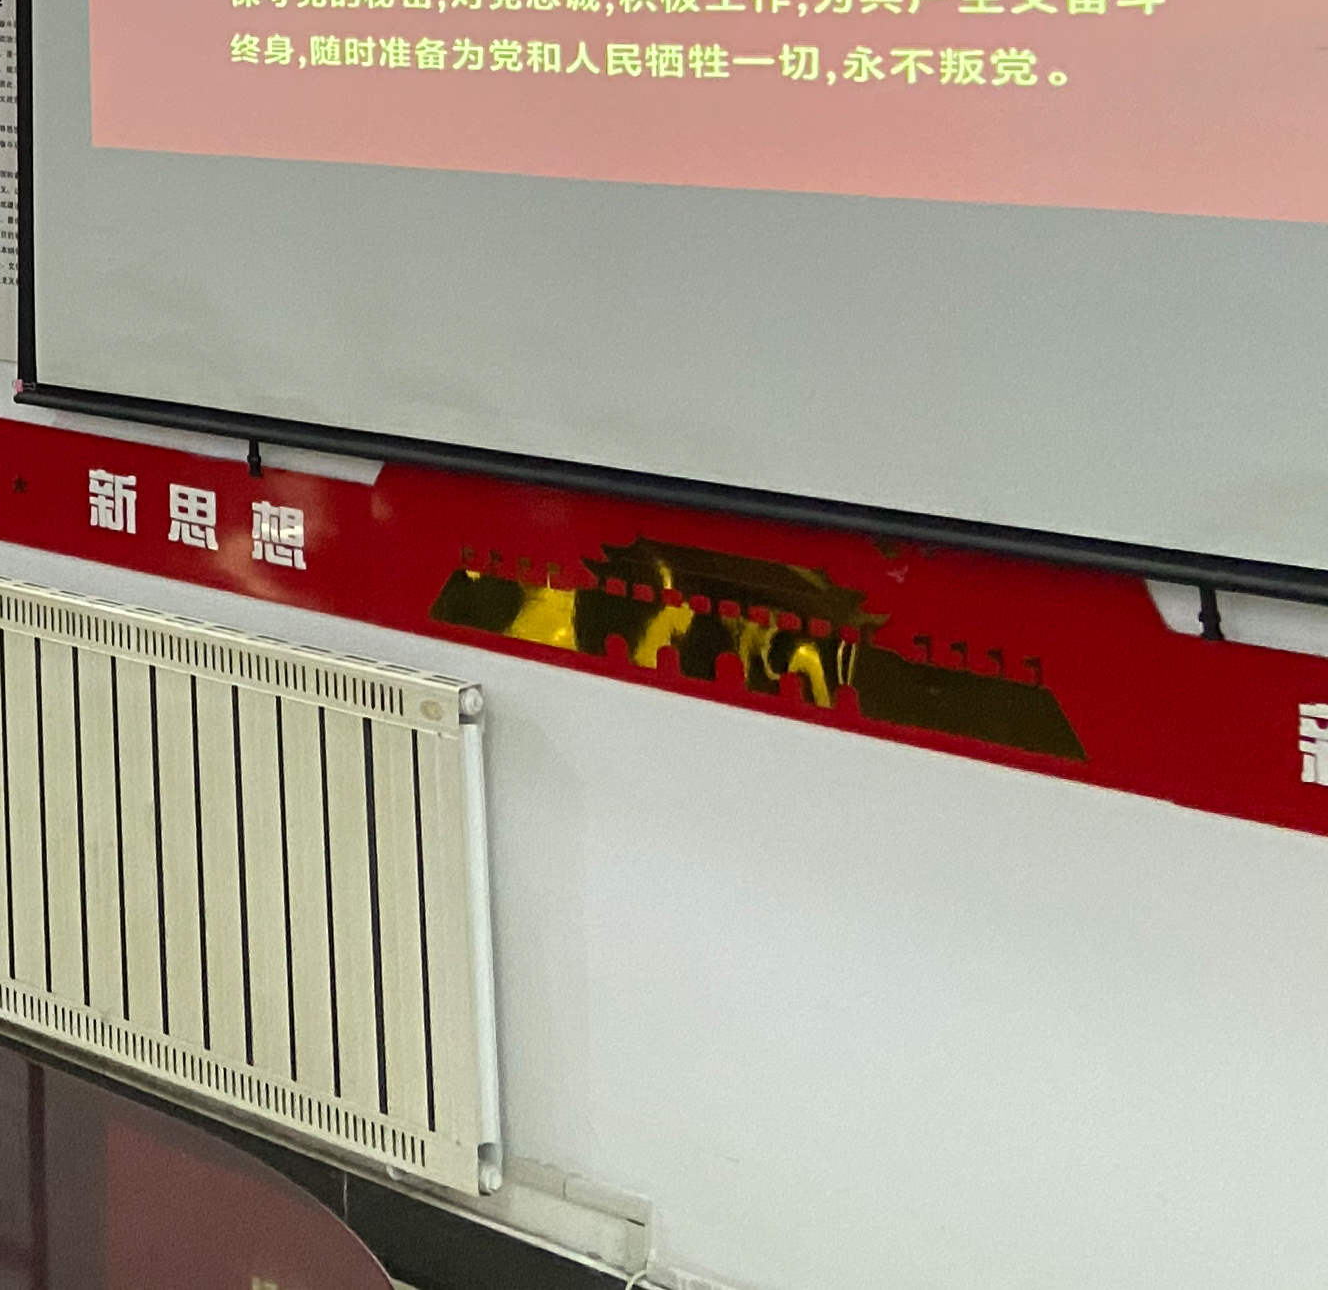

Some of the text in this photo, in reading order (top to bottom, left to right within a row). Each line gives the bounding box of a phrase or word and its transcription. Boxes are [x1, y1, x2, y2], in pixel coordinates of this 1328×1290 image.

[230, 34, 1068, 87] 终身，随时准备为党和人民牺牲一切，永不叛党。
[89, 469, 306, 570] 新思想
